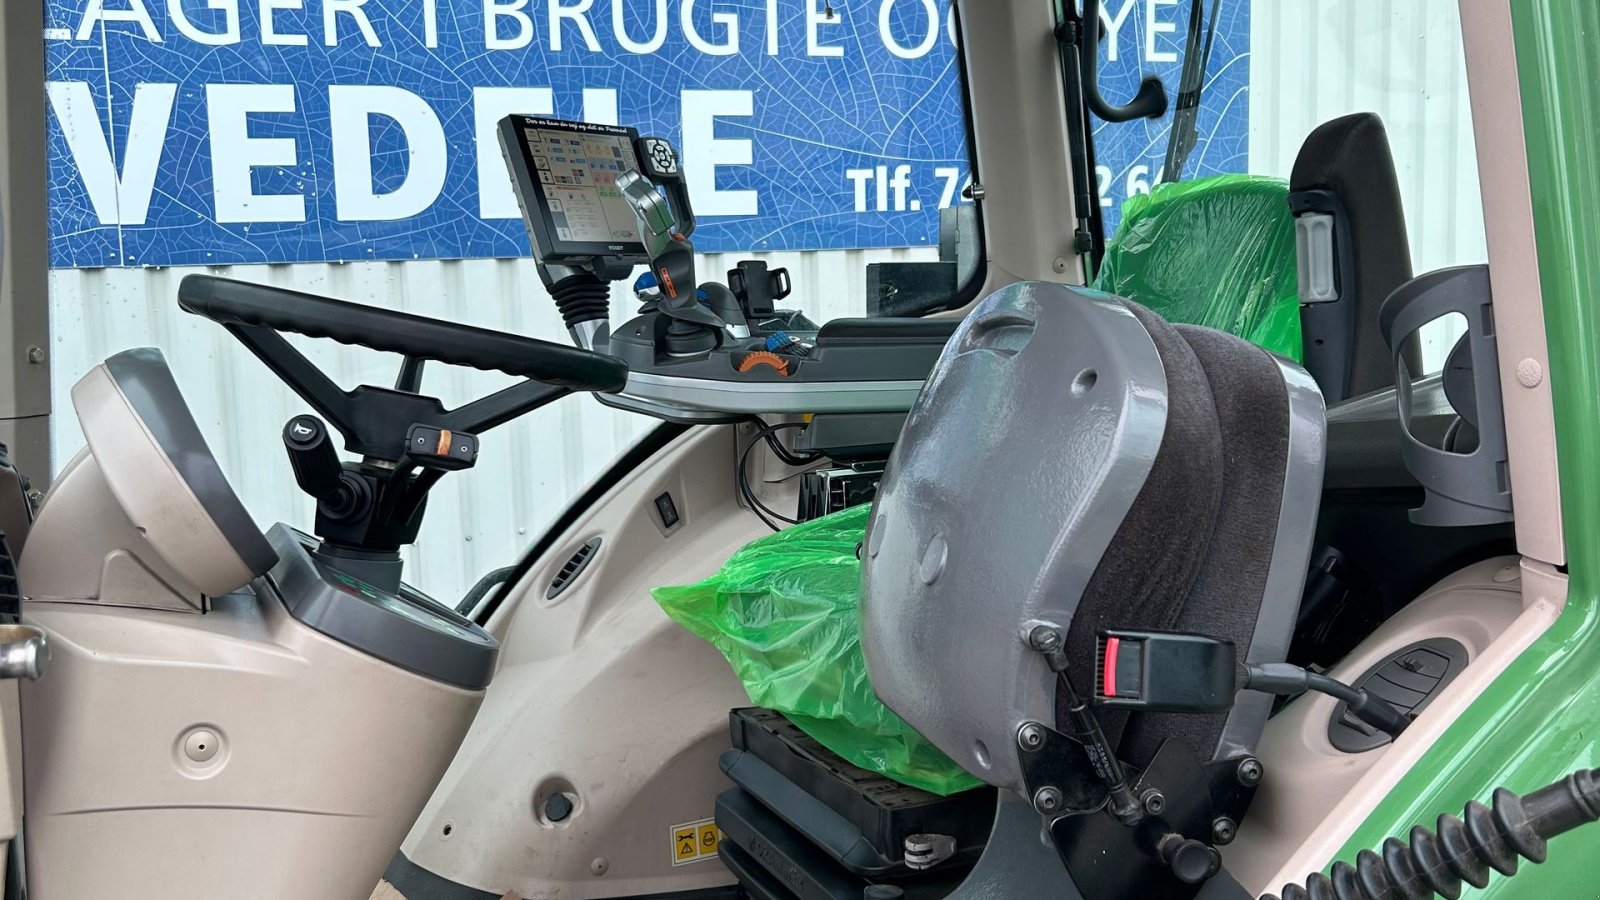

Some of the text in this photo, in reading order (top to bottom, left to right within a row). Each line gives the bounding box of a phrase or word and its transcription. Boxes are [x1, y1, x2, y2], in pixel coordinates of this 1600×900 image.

[44, 0, 382, 47] AGER
[878, 0, 958, 59] O
[846, 164, 920, 212] Tlf.
